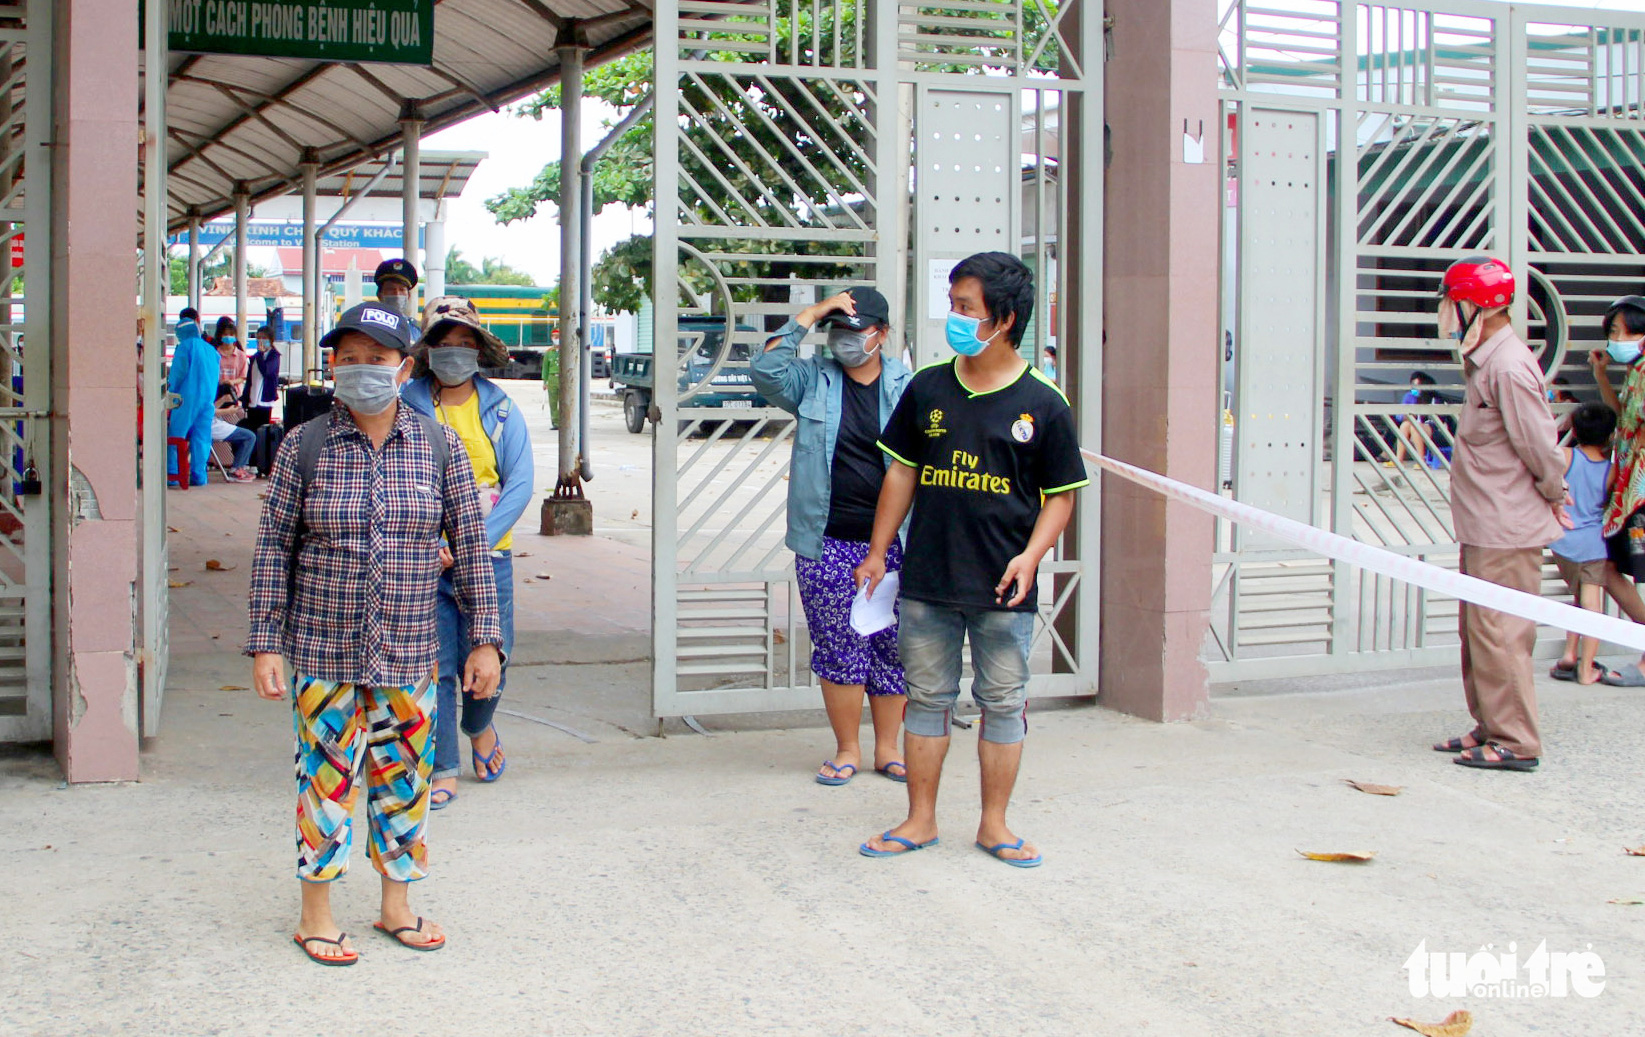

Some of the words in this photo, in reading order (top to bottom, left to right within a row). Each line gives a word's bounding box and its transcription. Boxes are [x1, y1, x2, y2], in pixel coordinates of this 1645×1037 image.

[308, 0, 348, 50] BỆNH
[352, 2, 386, 52] HIỆU
[390, 0, 420, 50] QUẢ
[363, 227, 402, 239] KHÁC
[281, 238, 293, 247] to
[366, 310, 395, 326] POLO
[952, 450, 979, 469] Fly
[920, 465, 1010, 495] Emirates
